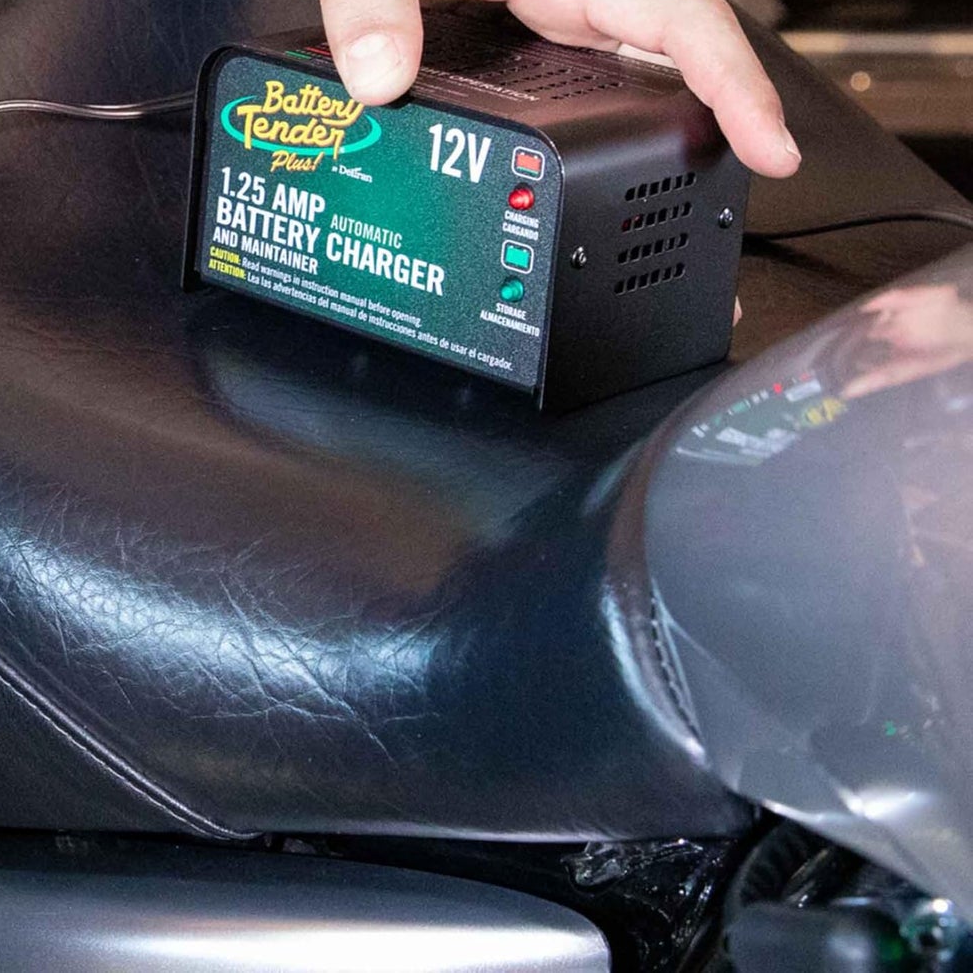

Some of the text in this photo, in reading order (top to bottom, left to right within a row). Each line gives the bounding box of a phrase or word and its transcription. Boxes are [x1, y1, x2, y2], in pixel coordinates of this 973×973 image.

[261, 80, 365, 127] Battery
[236, 104, 345, 161] Tender
[428, 123, 492, 183] 12V
[270, 149, 325, 173] Plus!
[221, 166, 326, 223] 1.25 AMP
[330, 213, 403, 249] AUTOMATIC
[502, 221, 539, 241] CARGANDO
[504, 210, 540, 229] CHARGING
[212, 226, 319, 275] AND MAINTAINER
[216, 195, 445, 296] BATTERY CHARGER
[209, 246, 242, 266] CAUTION:
[241, 257, 260, 273] Read
[260, 264, 292, 283] warnings
[292, 272, 301, 286] in
[300, 276, 339, 298] instruction
[339, 290, 367, 308] manual
[368, 299, 393, 317] before
[247, 271, 260, 286] Lea
[260, 277, 272, 290] las
[272, 282, 317, 305] advertencias
[317, 295, 330, 309] del
[329, 301, 358, 318] manual
[358, 309, 368, 322] de
[368, 314, 417, 339] instrucciones
[417, 331, 438, 346] antes
[439, 337, 450, 350] de
[450, 343, 468, 356] usar
[468, 347, 477, 359] el
[479, 309, 540, 338] ALMACENAMIENTO
[495, 302, 527, 322] STORAGE
